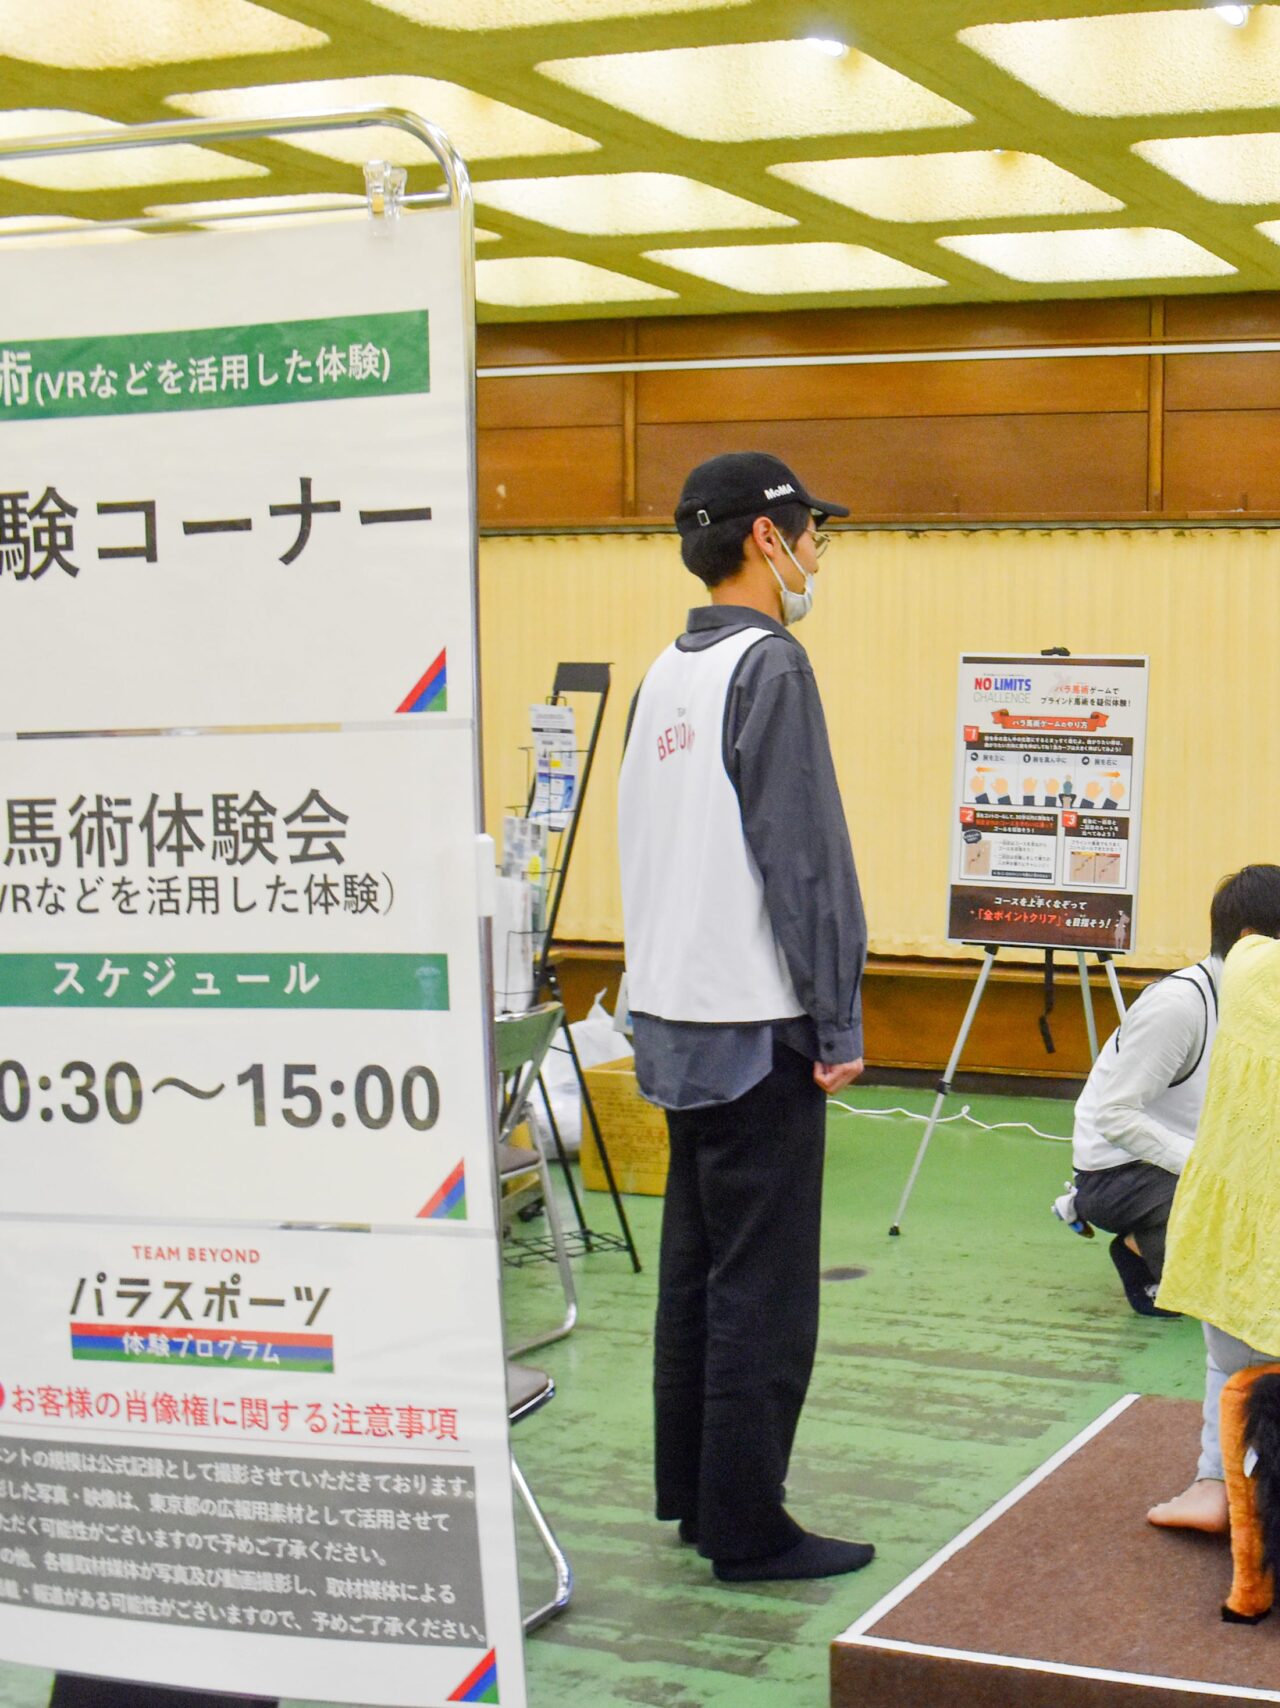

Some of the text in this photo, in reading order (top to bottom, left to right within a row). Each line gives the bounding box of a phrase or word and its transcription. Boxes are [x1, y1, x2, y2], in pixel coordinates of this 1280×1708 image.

[974, 677, 1031, 692] NO LIMITS
[974, 692, 1031, 704] CHALLENGE
[52, 957, 321, 999] スケジュール
[131, 1245, 261, 1264] TEAM BEYOND
[69, 1271, 332, 1327] パラスポーツ
[121, 1331, 281, 1365] 体験プログラム
[11, 1384, 460, 1441] お客様の肖像権に関する注意事項
